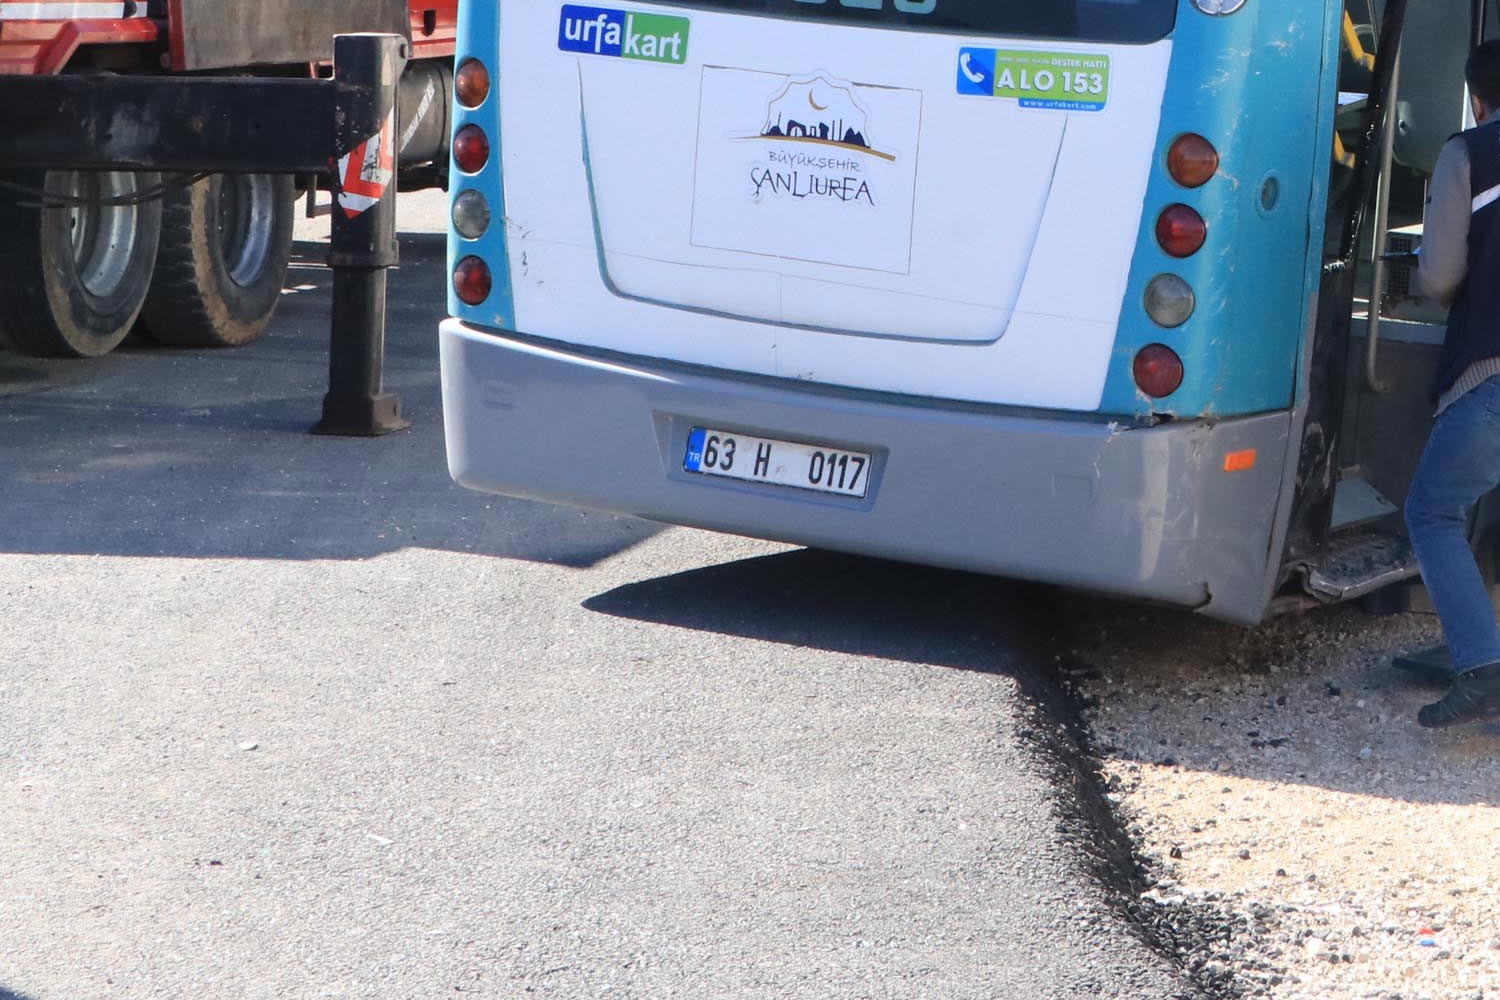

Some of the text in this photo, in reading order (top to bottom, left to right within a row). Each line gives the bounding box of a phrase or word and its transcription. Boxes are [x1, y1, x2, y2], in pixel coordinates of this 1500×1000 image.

[565, 13, 681, 61] urfakart
[1051, 57, 1081, 68] DESTEK
[997, 68, 1103, 94] ALO 153
[768, 150, 863, 172] BÜYÜKŞEHİR
[688, 436, 866, 490] TR 63 H 0117
